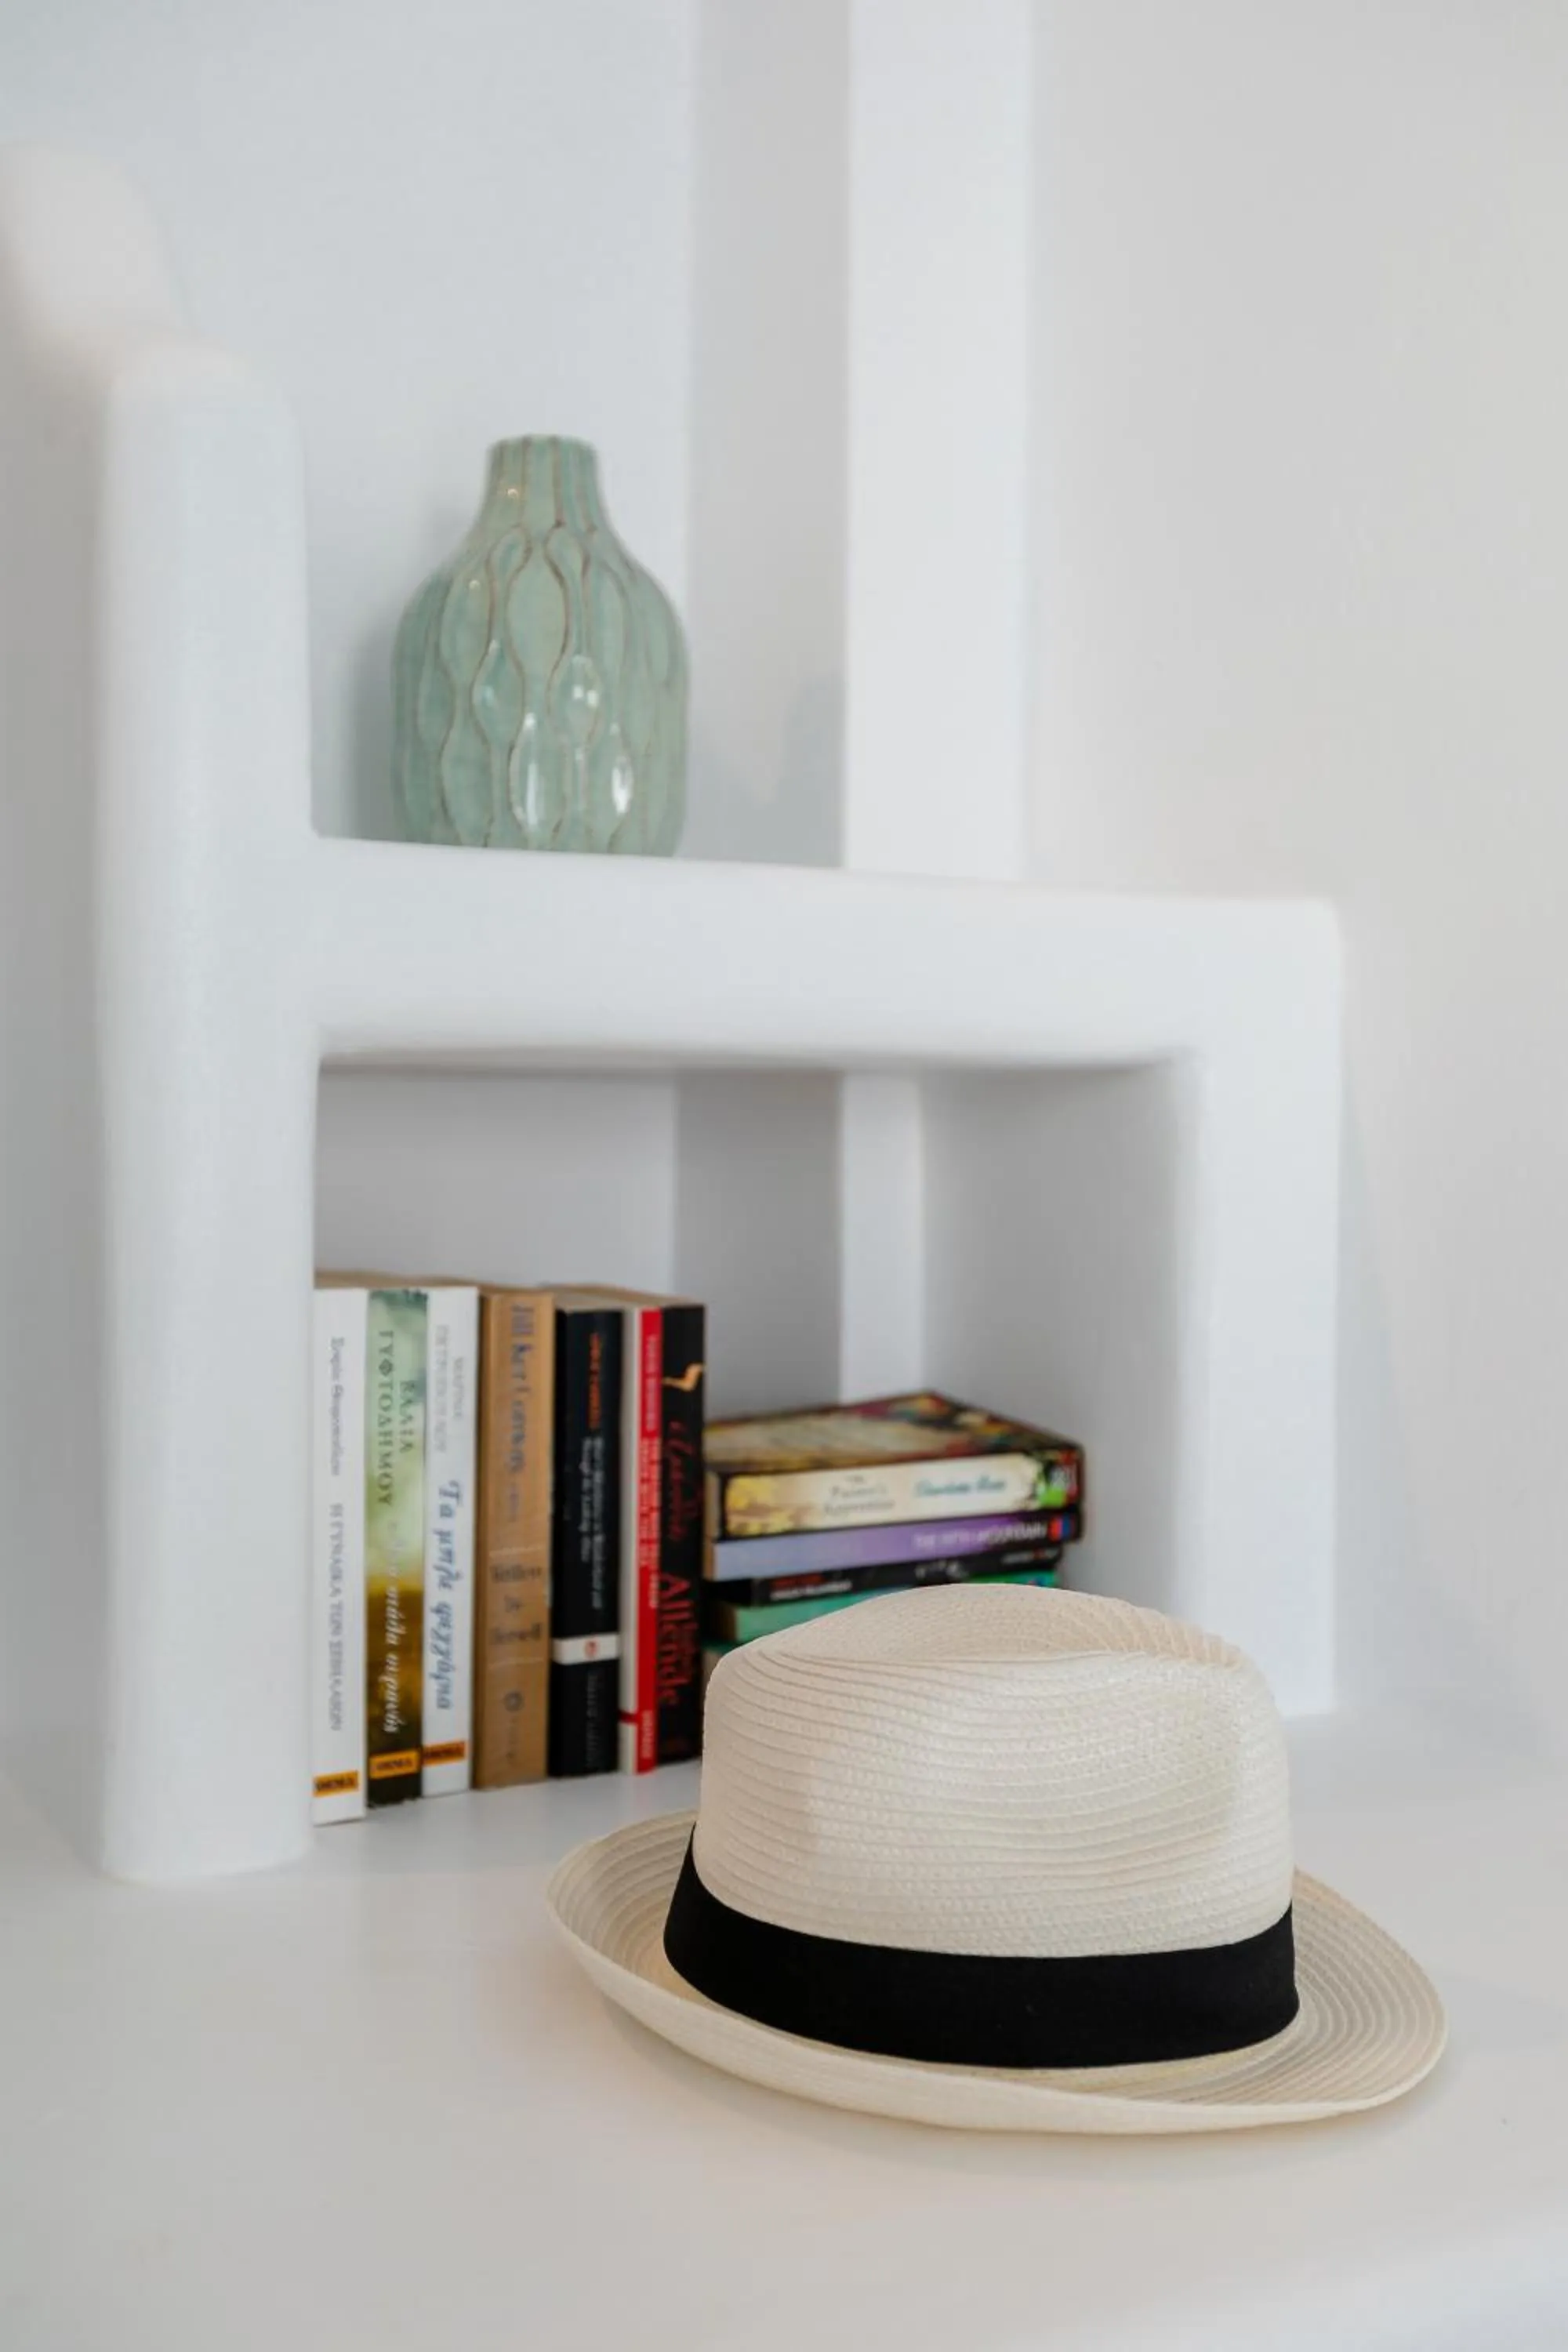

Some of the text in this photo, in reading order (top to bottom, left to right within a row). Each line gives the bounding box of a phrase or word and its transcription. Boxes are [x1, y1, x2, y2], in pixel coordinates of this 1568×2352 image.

[378, 1330, 394, 1506] ΓΥΦΤΟΔΗΜΟΥ
[399, 1380, 416, 1454] ΒΑΛΙΑ
[430, 1480, 463, 1711] Τα μπλε φεγγάρια
[658, 1572, 695, 1705] Allende
